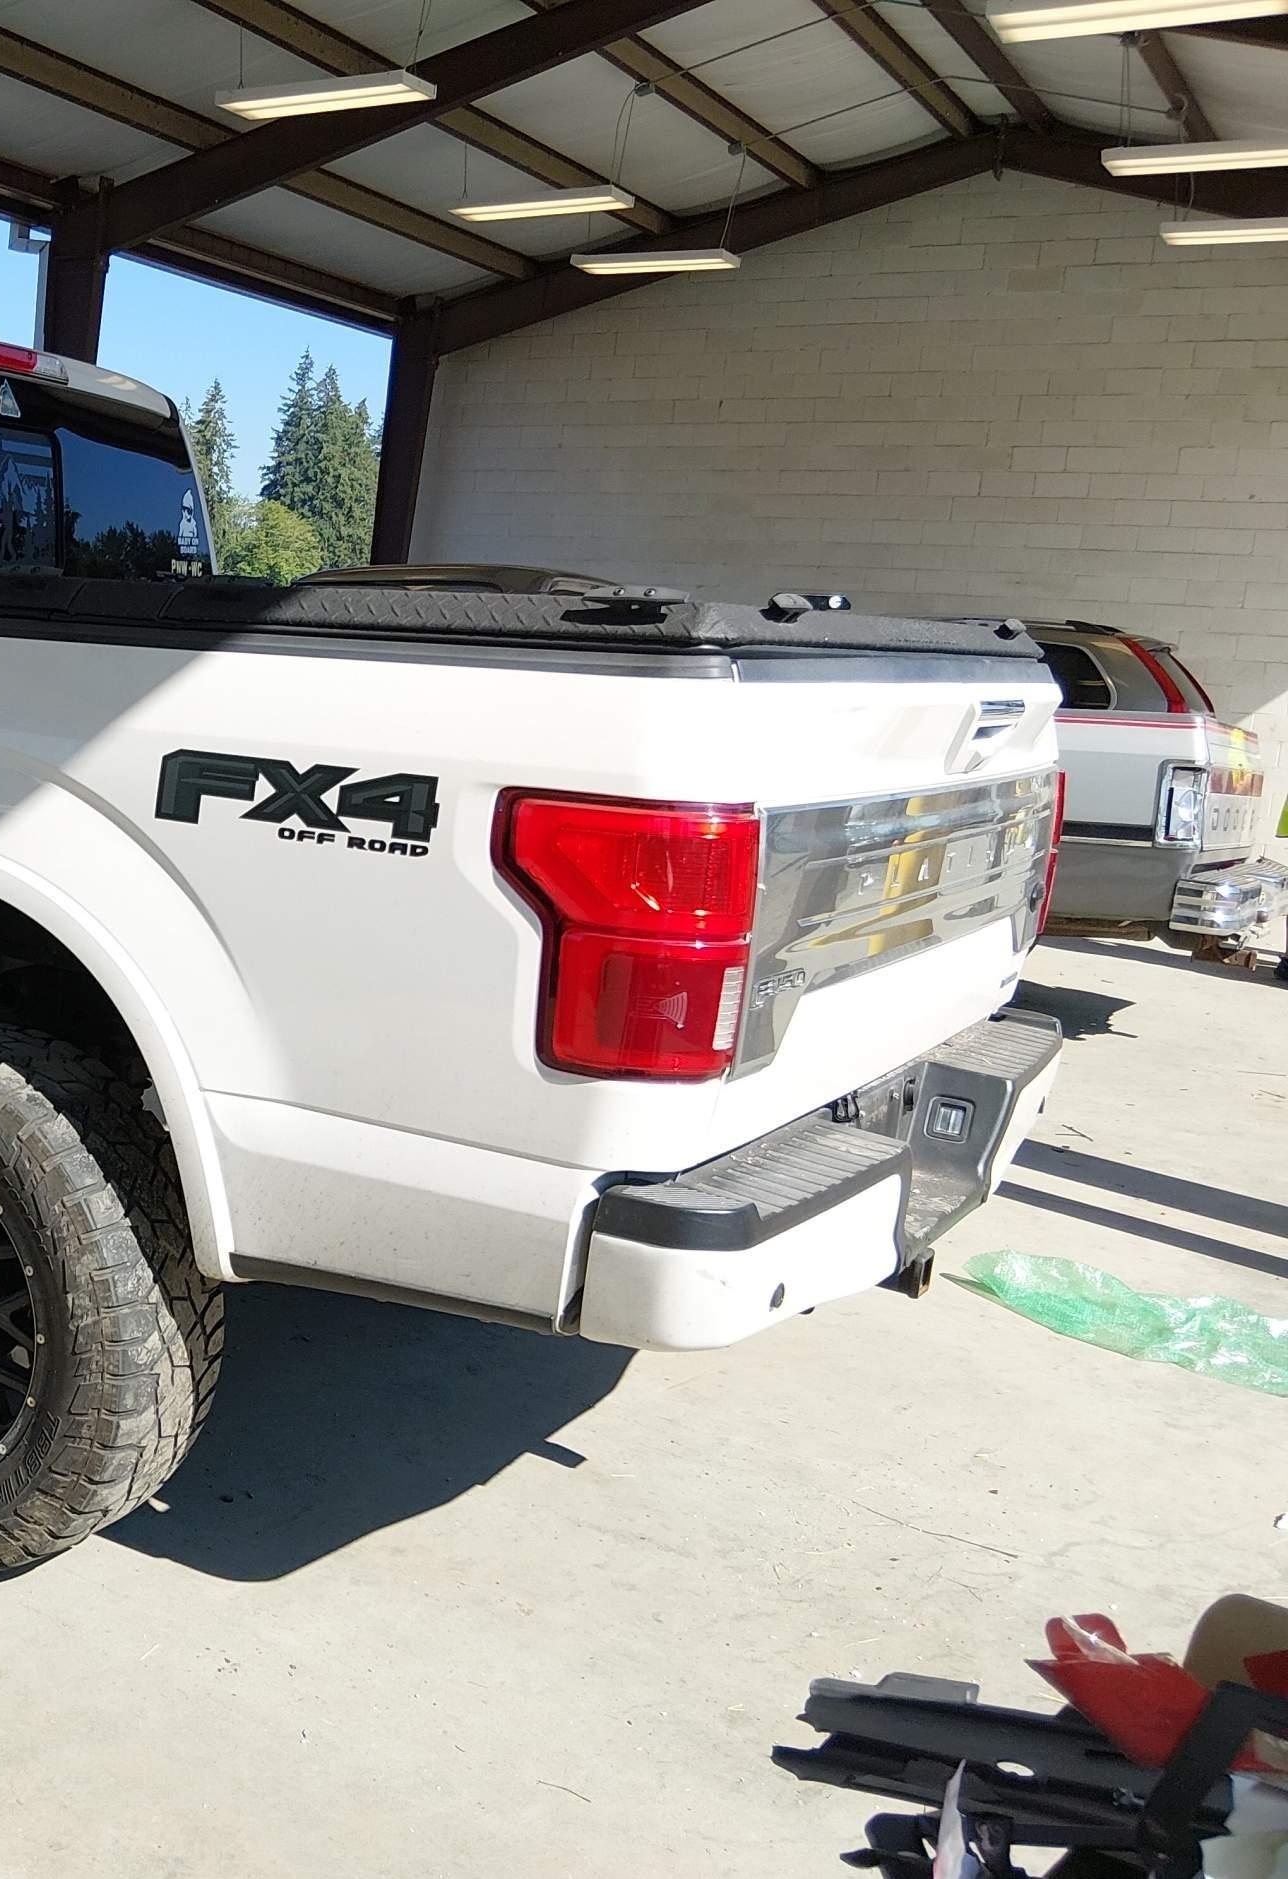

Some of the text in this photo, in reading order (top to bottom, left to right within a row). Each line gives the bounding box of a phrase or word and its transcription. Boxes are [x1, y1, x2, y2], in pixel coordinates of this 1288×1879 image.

[154, 748, 440, 843] FX4
[278, 827, 429, 857] OFF ROAD
